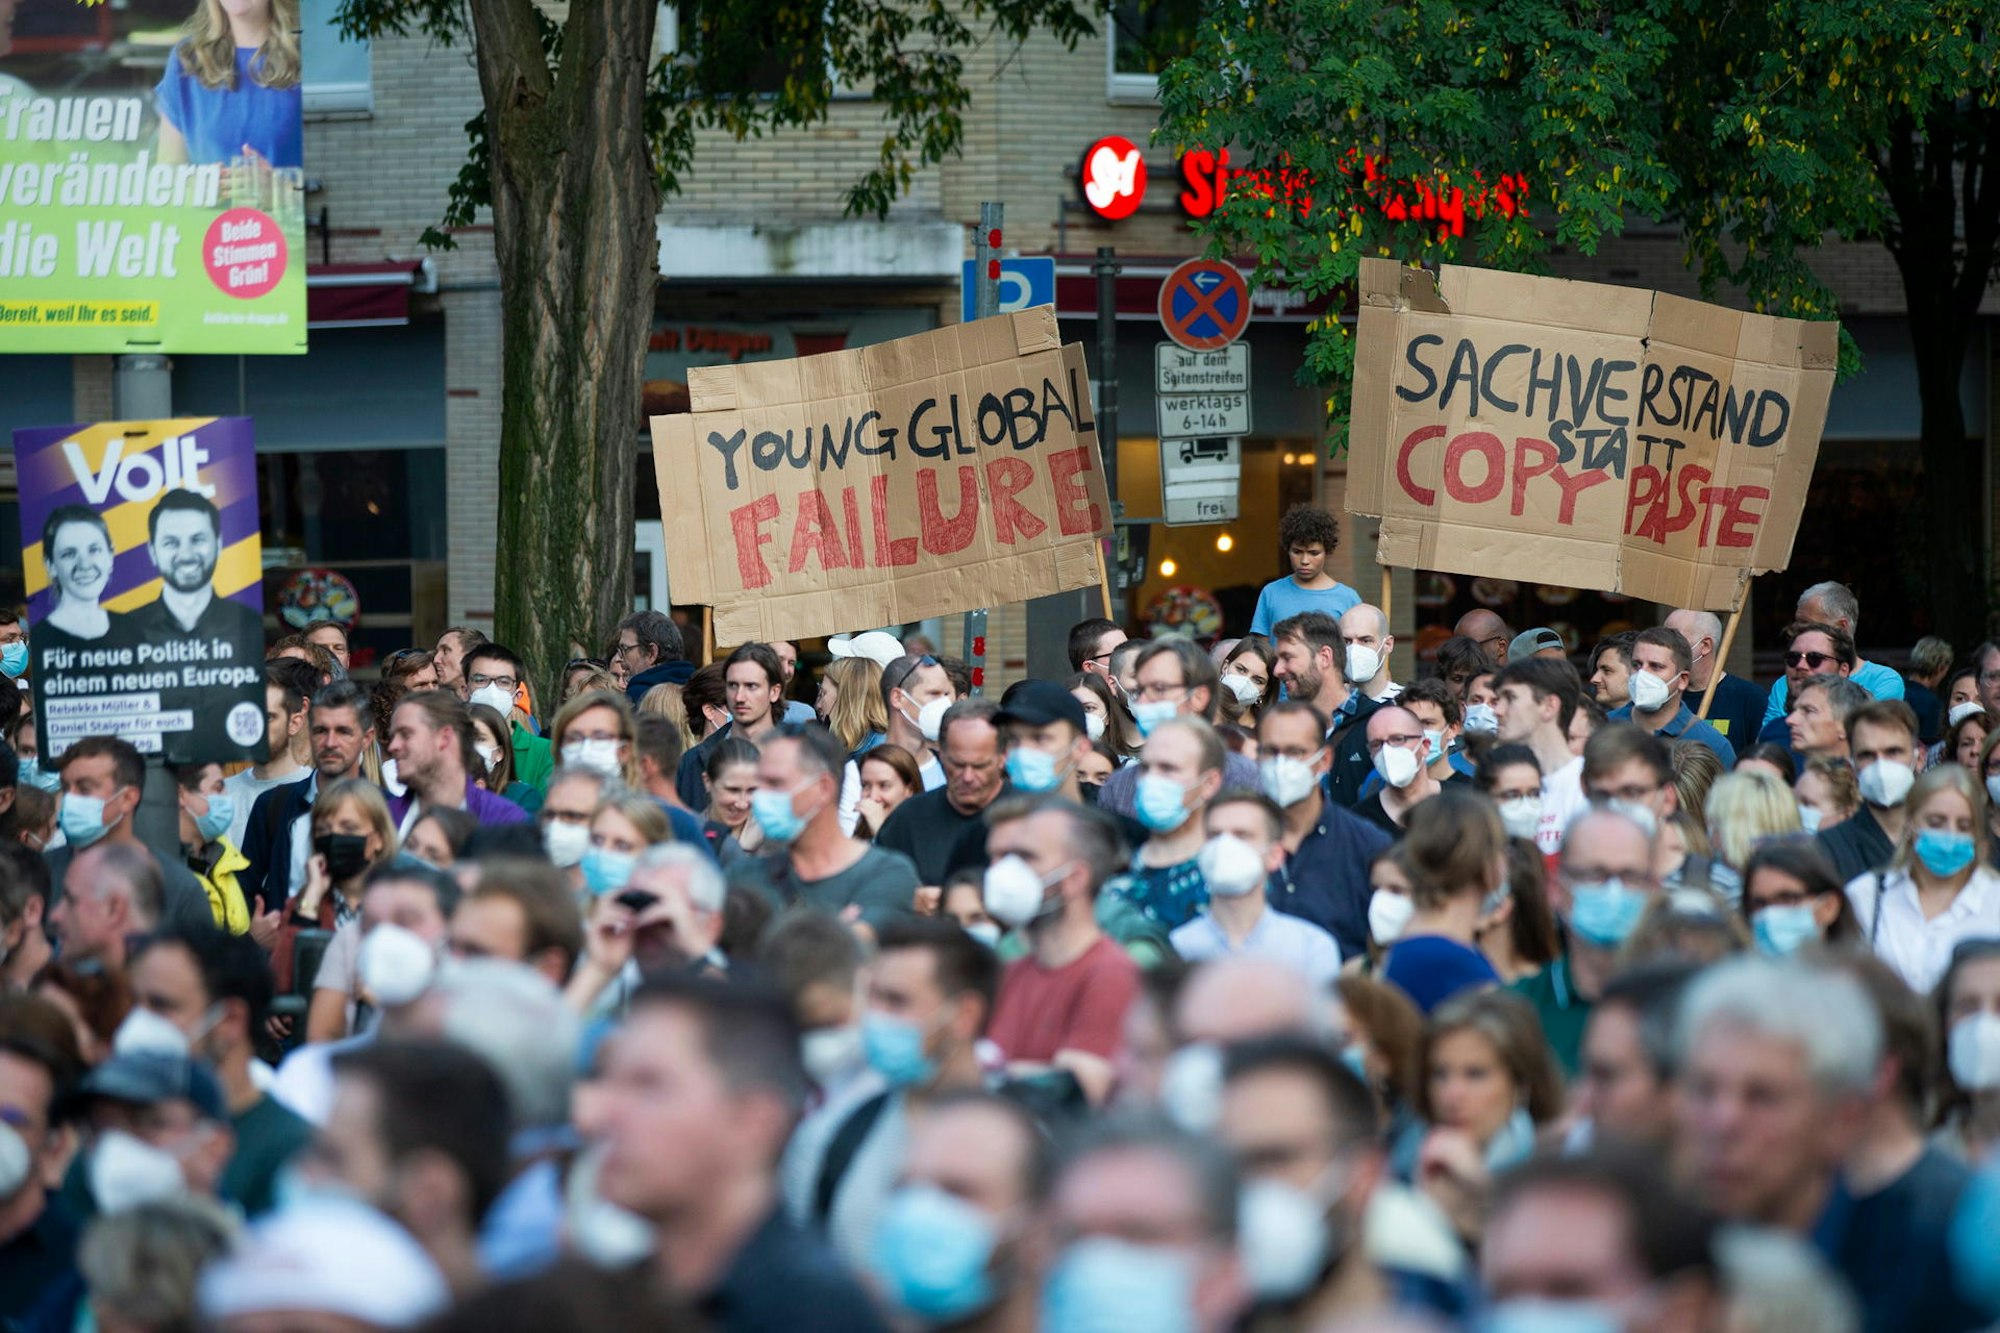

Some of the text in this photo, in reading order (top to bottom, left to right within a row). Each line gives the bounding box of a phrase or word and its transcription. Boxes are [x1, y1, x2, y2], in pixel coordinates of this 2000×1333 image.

[221, 217, 262, 243] Beide
[76, 221, 180, 278] Welt
[212, 241, 278, 268] Stimmen
[45, 304, 76, 322] weil
[78, 304, 98, 322] Ihr
[101, 308, 118, 322] es
[121, 305, 154, 322] seid.
[1178, 353, 1228, 367] auf dem
[1163, 370, 1243, 385] Seitenstreifen
[1396, 334, 1790, 448] SACHVERSTAND
[1165, 395, 1243, 412] werktags
[707, 368, 1096, 491] YOUNG GLOBAL
[1549, 419, 1686, 480] STATT
[62, 436, 217, 504] Volt
[1397, 424, 1770, 548] COPY PASTE
[730, 446, 1103, 590] FAILURE
[1197, 501, 1226, 516] frei
[43, 638, 233, 669] Für neue Politik in
[44, 665, 260, 696] einem neuen Europa.
[50, 722, 87, 734] Daniel
